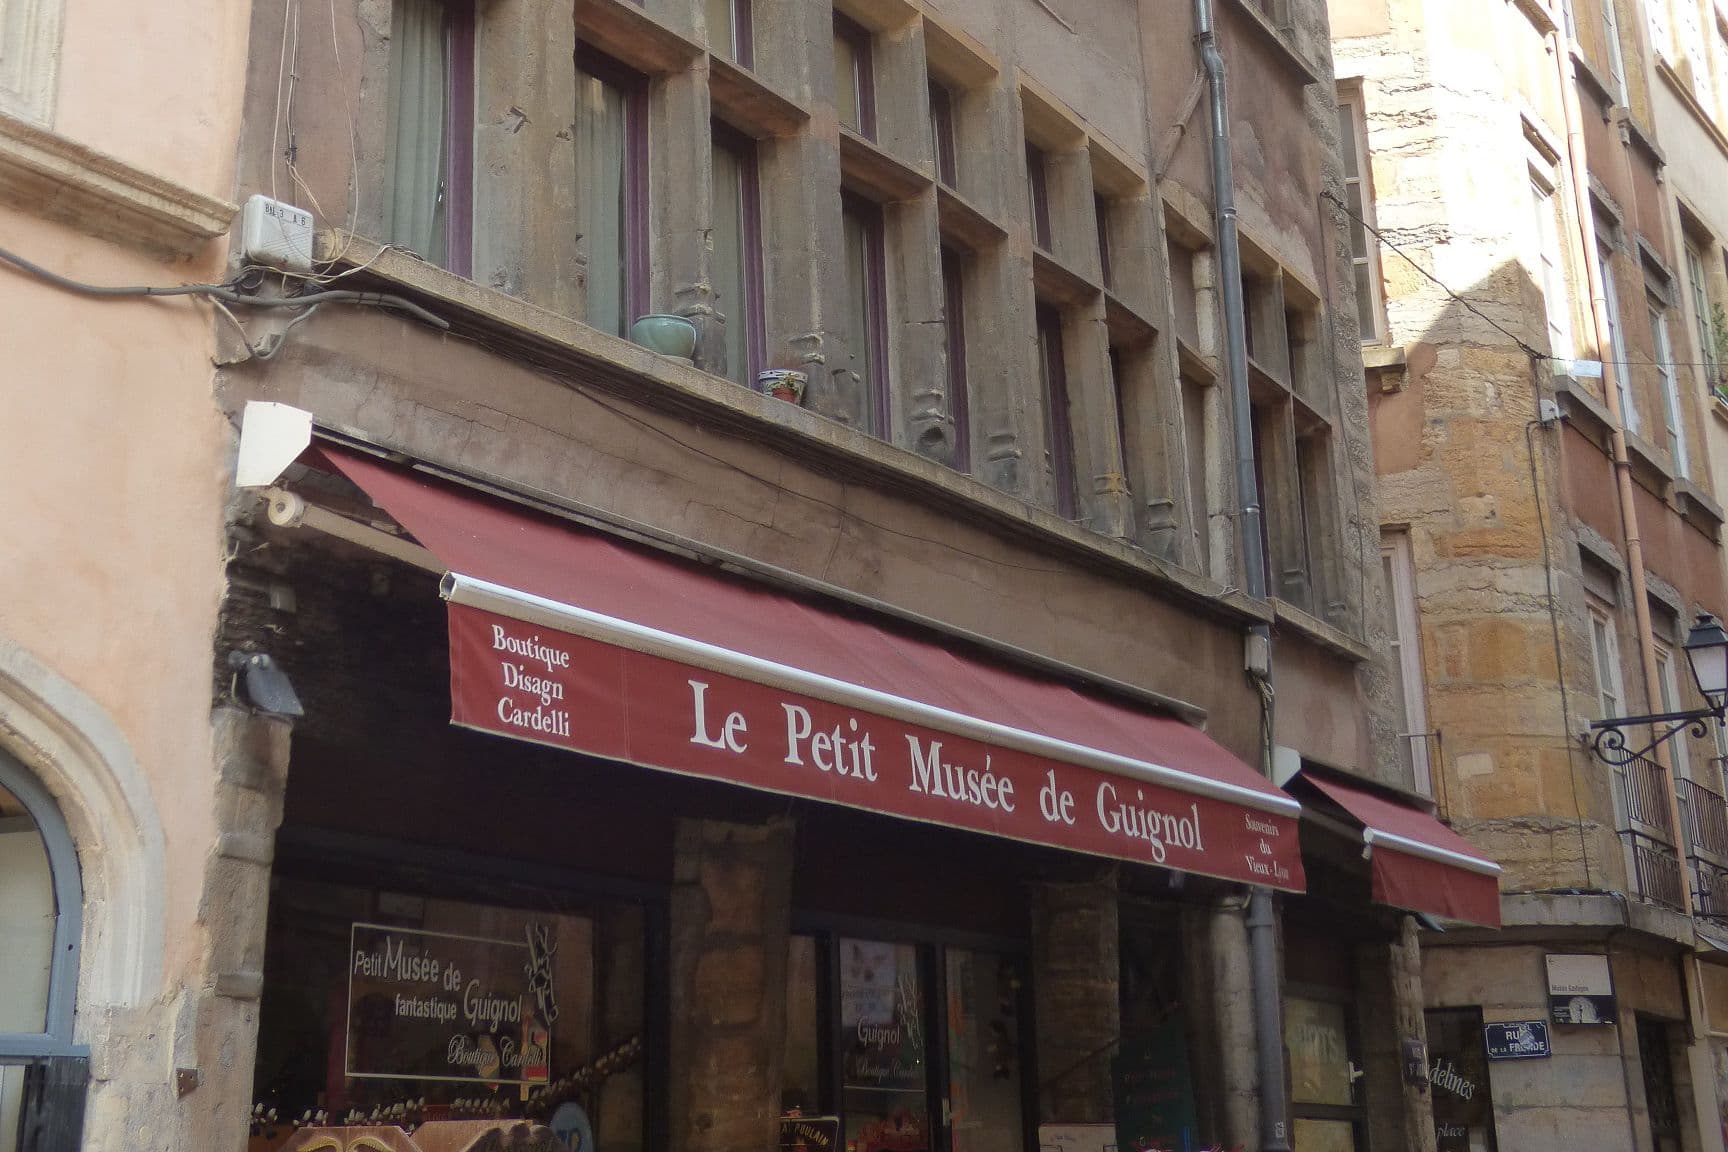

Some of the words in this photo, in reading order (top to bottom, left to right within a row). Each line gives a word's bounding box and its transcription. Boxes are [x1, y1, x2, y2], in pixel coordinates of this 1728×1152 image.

[491, 624, 570, 669] Boutique
[502, 661, 563, 707] Disagn
[497, 697, 571, 737] Cardelli
[687, 679, 748, 754] Le
[781, 701, 878, 783] Petit
[904, 733, 1016, 813] Musée
[1039, 768, 1076, 826] de
[1096, 781, 1205, 863] Guignol
[1245, 814, 1279, 836] Souvenirs
[1259, 838, 1272, 855] du
[353, 949, 383, 977] Petit
[383, 935, 440, 984] Musée
[443, 961, 461, 992] de
[463, 978, 523, 1032] Guignol
[394, 992, 457, 1025] fantastique
[857, 1017, 900, 1049] Guignol
